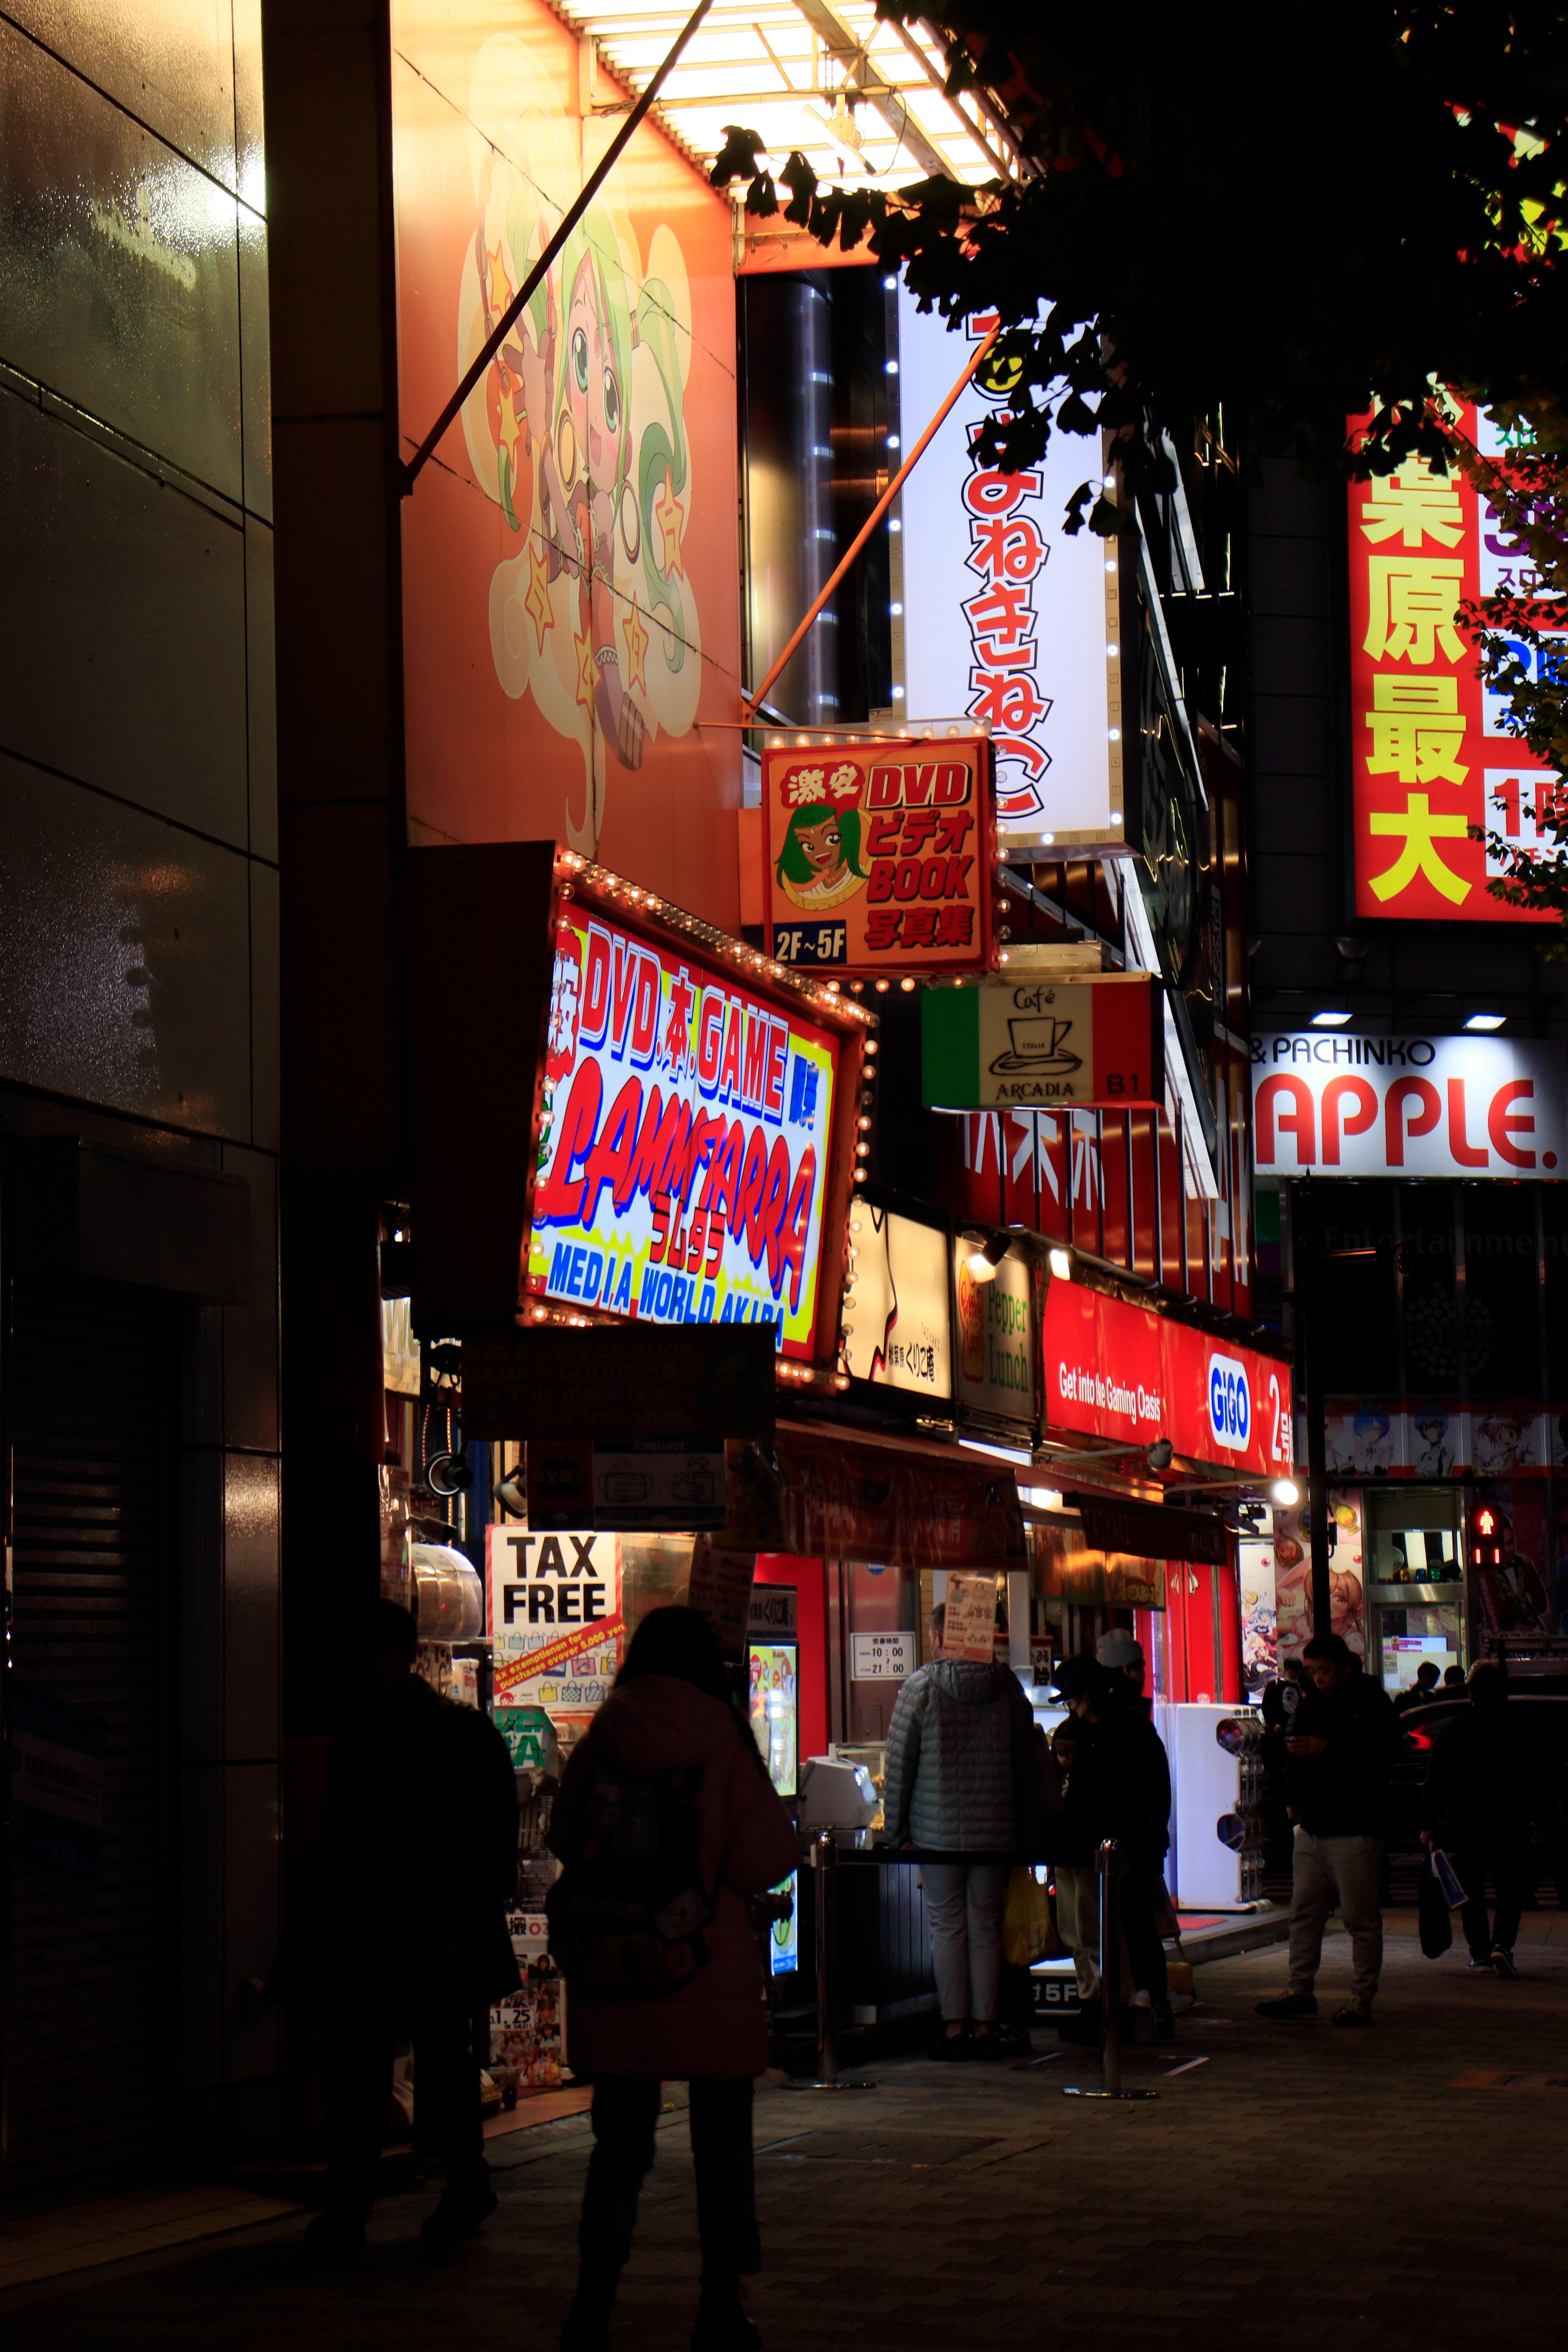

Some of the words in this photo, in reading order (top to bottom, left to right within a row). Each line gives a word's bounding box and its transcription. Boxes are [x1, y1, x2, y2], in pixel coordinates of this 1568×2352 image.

[1360, 372, 1472, 906] 葉原最大
[788, 764, 860, 804] 激安
[865, 762, 972, 810] DVD
[866, 810, 975, 856] ビデオ
[866, 855, 974, 903] BOOK
[864, 904, 975, 951] 写真集
[1013, 987, 1056, 1013] Café
[1273, 1037, 1436, 1066] PACHINKO
[996, 1082, 1075, 1100] ARCADIA
[1107, 1074, 1138, 1094] B1
[1255, 1073, 1558, 1169] APPLE.
[649, 1192, 727, 1281] ラムタラ
[548, 1242, 632, 1310] MEDIA
[639, 1267, 717, 1324] WORLD
[988, 1279, 1027, 1335] Pepper
[921, 1322, 940, 1352] TAIYAKI
[989, 1333, 1029, 1393] Lunch
[1059, 1361, 1078, 1401] Get
[1078, 1366, 1095, 1405] into
[1096, 1372, 1106, 1409] the
[1106, 1375, 1137, 1425] Gaming
[1138, 1384, 1161, 1422] Oasis
[507, 1536, 598, 1579] TAX
[503, 1583, 607, 1624] FREE
[499, 1663, 547, 1690] purchases
[607, 1623, 625, 1639] yen
[568, 1633, 583, 1646] for
